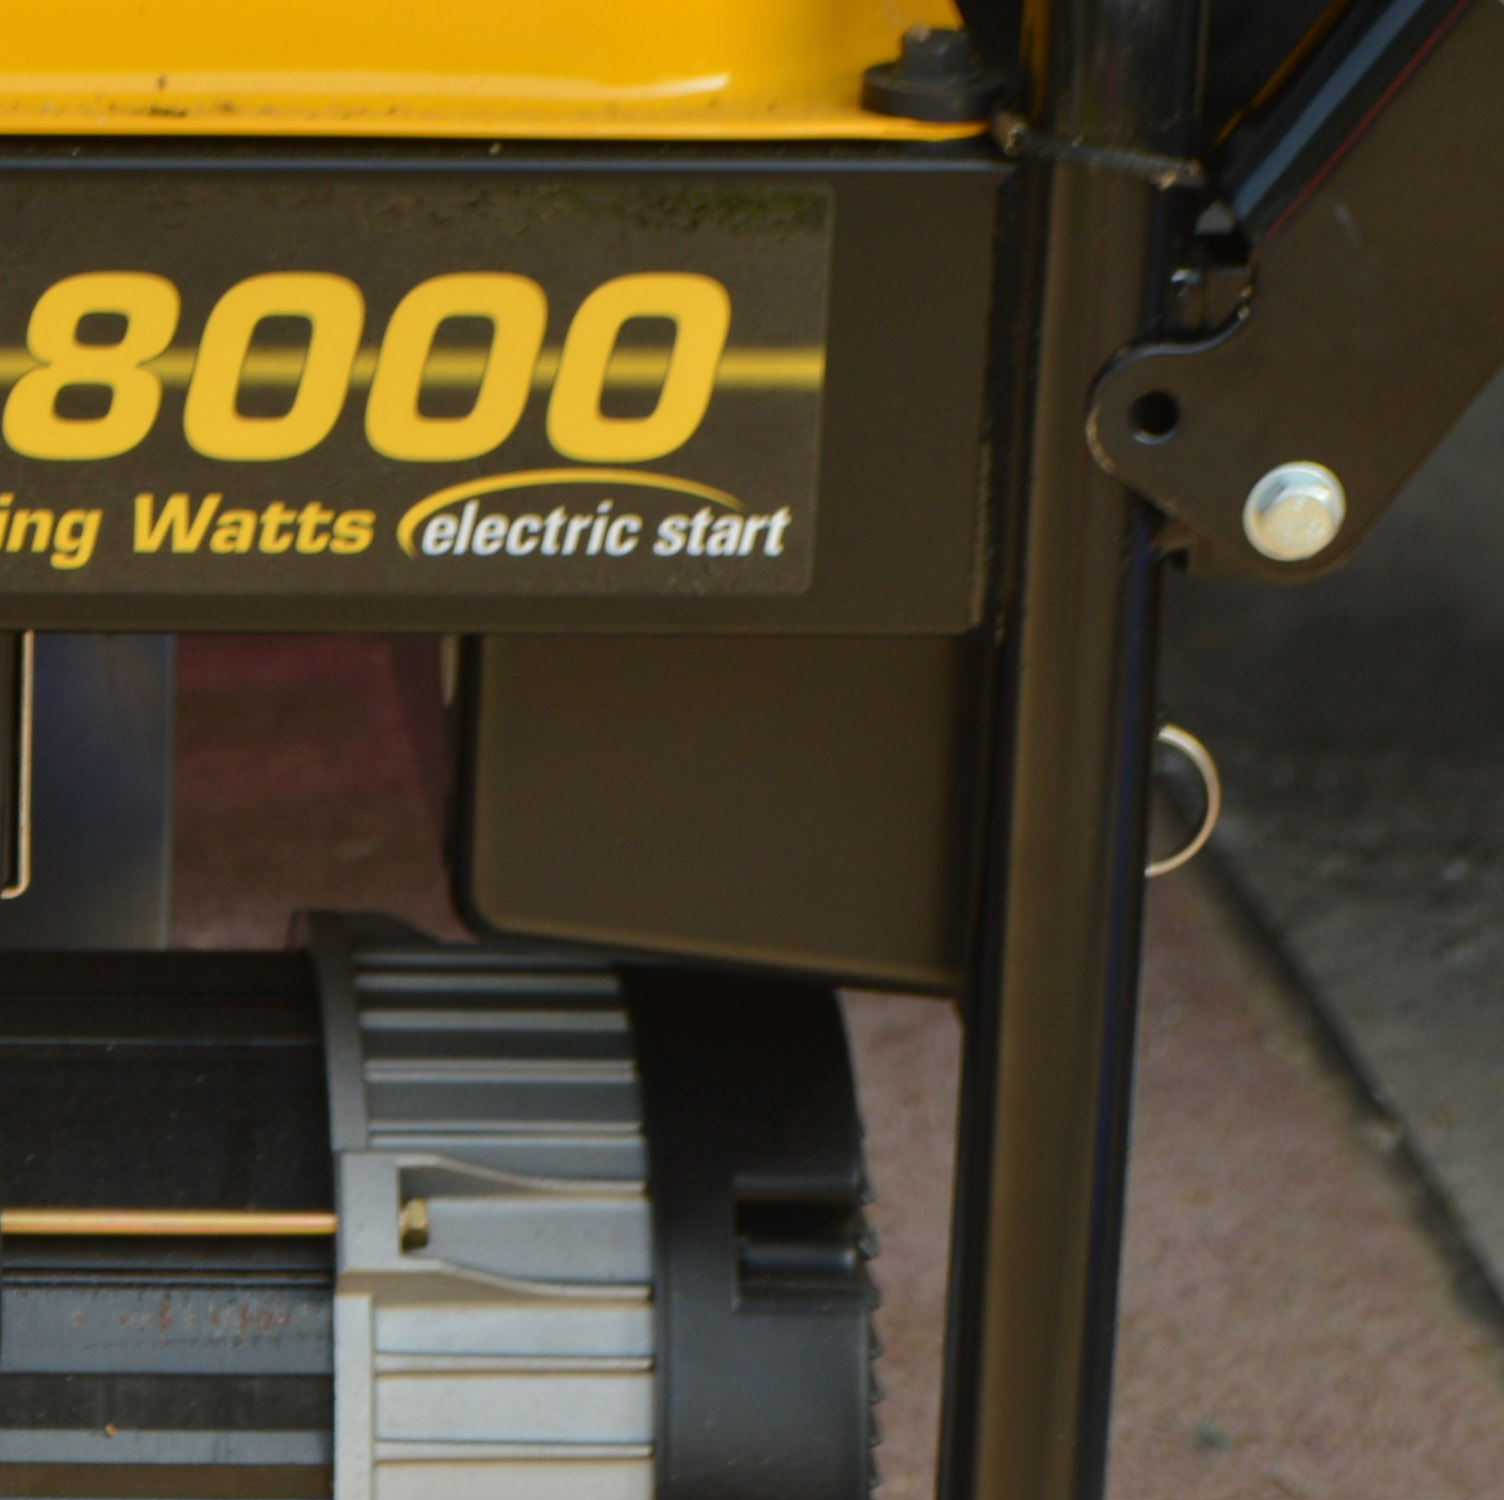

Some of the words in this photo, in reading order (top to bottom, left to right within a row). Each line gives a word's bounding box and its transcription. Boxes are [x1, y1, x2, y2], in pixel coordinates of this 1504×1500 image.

[130, 492, 376, 554] Watts
[421, 500, 642, 556] electric
[652, 504, 792, 556] start
